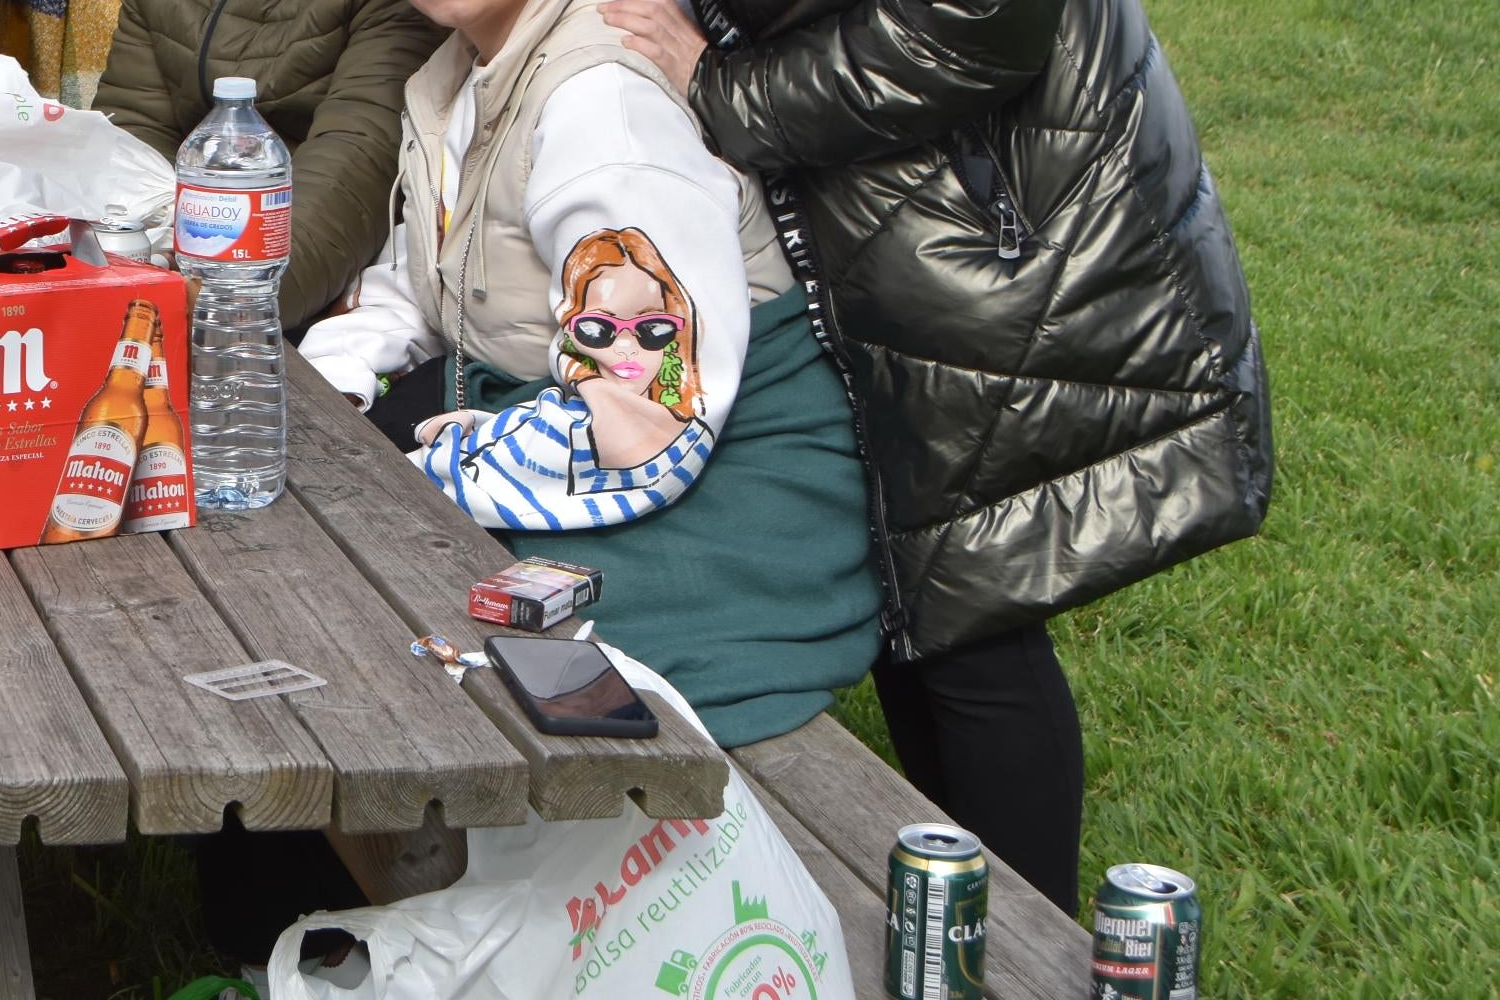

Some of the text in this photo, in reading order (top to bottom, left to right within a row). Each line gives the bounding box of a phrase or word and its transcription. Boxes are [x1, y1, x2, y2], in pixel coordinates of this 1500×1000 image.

[180, 202, 242, 221] AGUADOY
[208, 223, 233, 231] GREDOS
[2, 305, 25, 317] 1890
[7, 420, 45, 436] Sabor
[4, 436, 57, 451] Estrellas
[76, 431, 96, 447] CINCO
[94, 441, 112, 450] 1890
[11, 452, 44, 460] ESPECIAL
[67, 460, 125, 487] Mahou
[149, 462, 167, 470] 1890
[132, 481, 185, 502] Mahou
[637, 802, 747, 932] reutilizable
[703, 929, 740, 971] FABRICACIÓN
[754, 922, 785, 936] RECICLADO
[1124, 939, 1153, 957] Bier
[725, 955, 763, 997] Fabricadas
[1115, 966, 1149, 975] LAGER
[740, 971, 763, 998] con un
